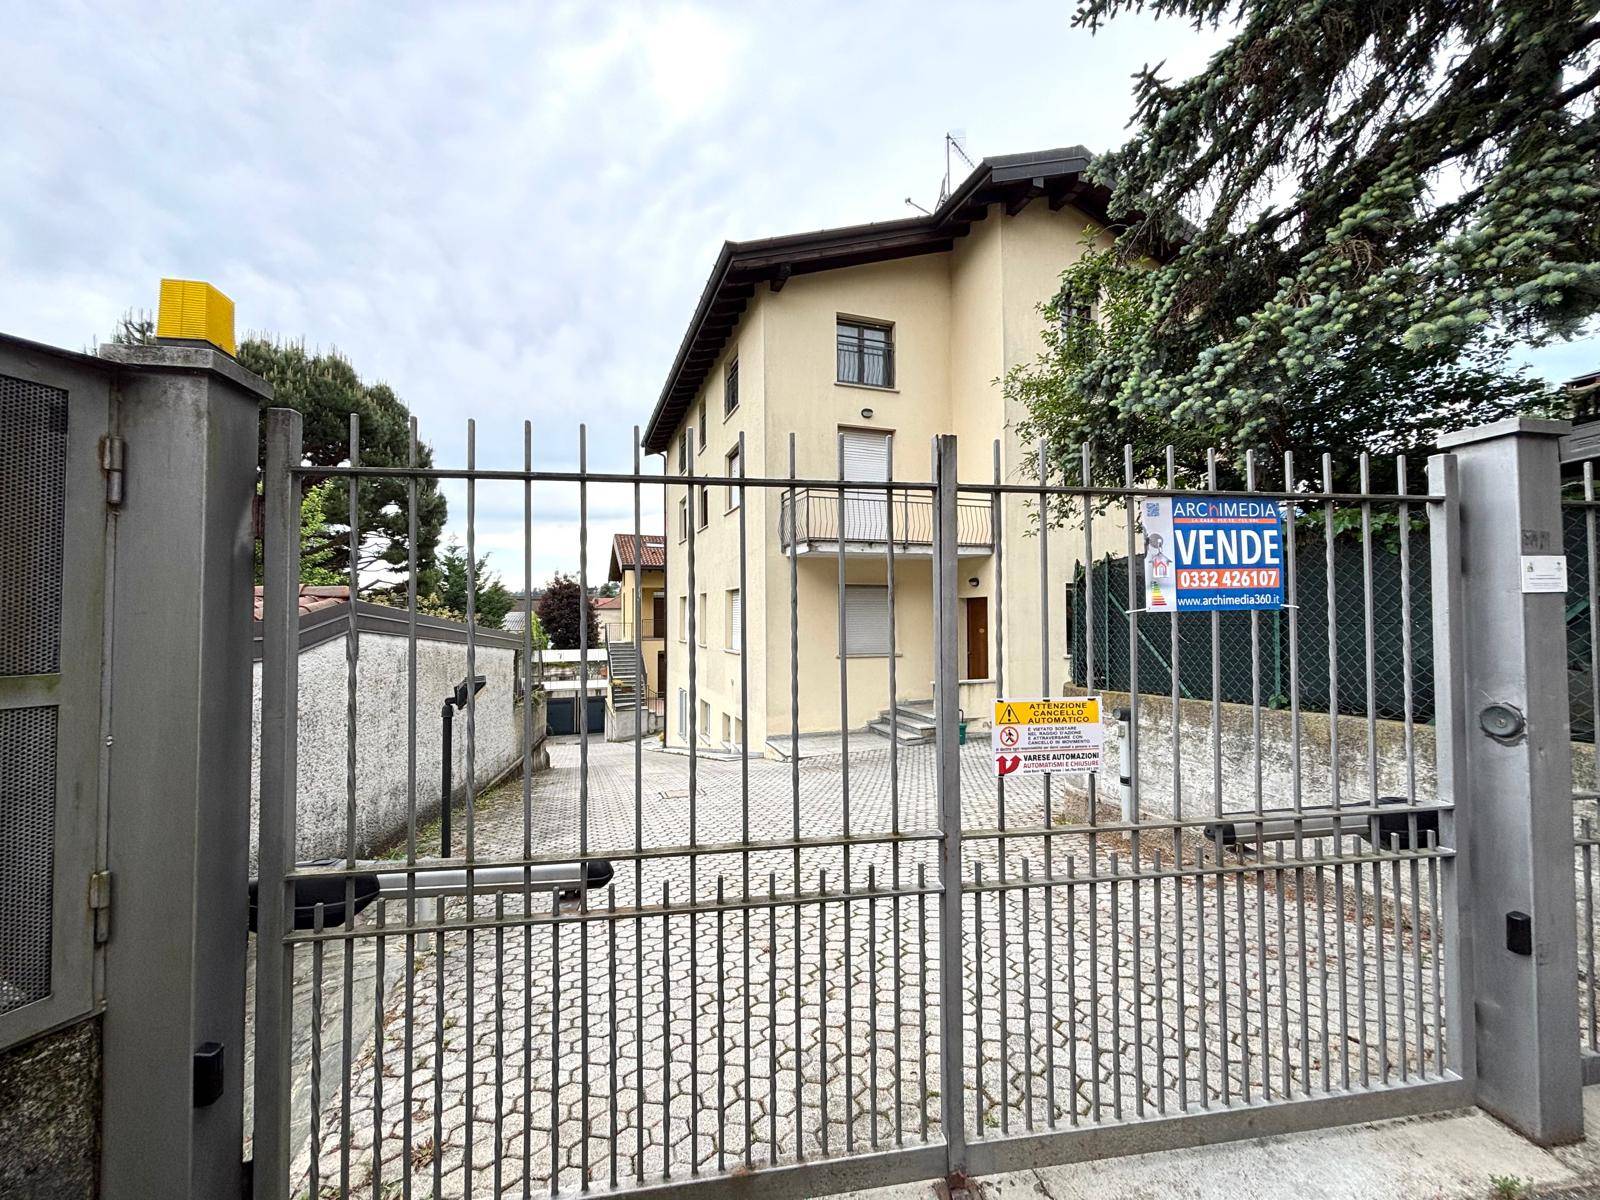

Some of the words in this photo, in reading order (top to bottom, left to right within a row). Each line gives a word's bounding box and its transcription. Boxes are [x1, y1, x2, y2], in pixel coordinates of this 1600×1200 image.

[1175, 530, 1280, 565] VENDE
[1180, 571, 1218, 588] 0332
[1222, 570, 1277, 587] 426107
[1177, 594, 1280, 606] www.archimedia360.it
[1029, 702, 1087, 710] ATTENZIONE
[1028, 716, 1089, 724] AUTOMATICO
[1051, 752, 1099, 760] AUTOMAZIONI
[1023, 761, 1065, 769] AUTOMATISMI
